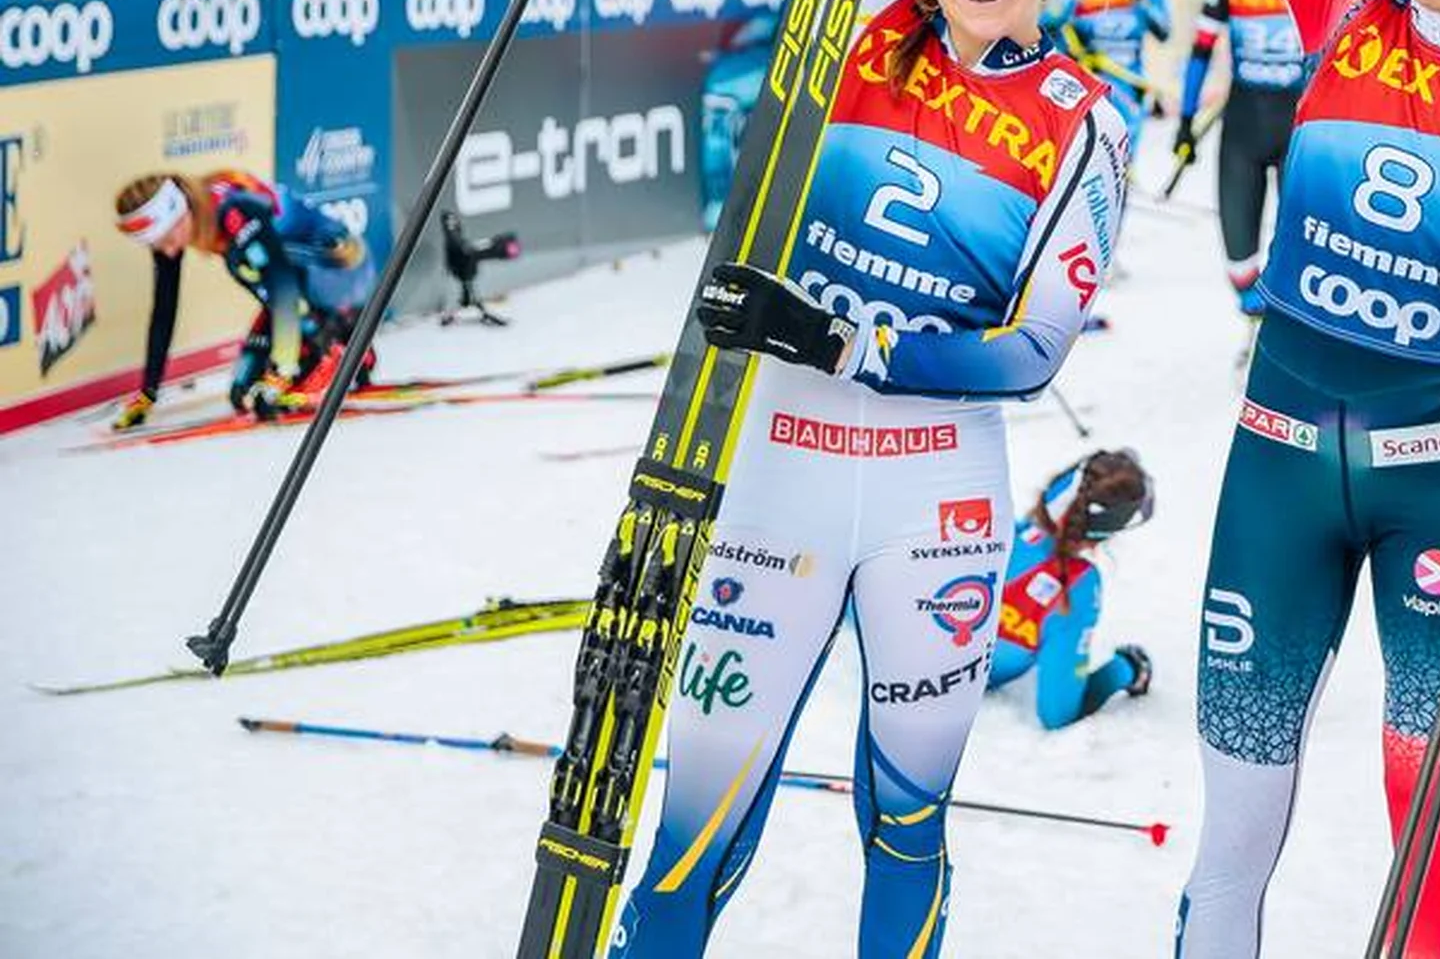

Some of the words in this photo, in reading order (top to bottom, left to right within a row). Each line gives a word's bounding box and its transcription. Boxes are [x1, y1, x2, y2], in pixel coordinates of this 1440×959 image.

[0, 0, 113, 73] coop
[905, 54, 1057, 193] EXTRA
[455, 105, 685, 216] e-tron
[863, 146, 942, 247] 2
[1353, 143, 1436, 233] 8
[806, 221, 977, 304] fiemme
[1058, 241, 1099, 313] ICA
[773, 416, 957, 453] BAUHAUS
[634, 473, 706, 502] FISCHER
[911, 542, 983, 559] SVENSKA
[914, 598, 982, 613] Thermia
[870, 656, 983, 704] CRAFT
[539, 837, 611, 871] FISCHER
